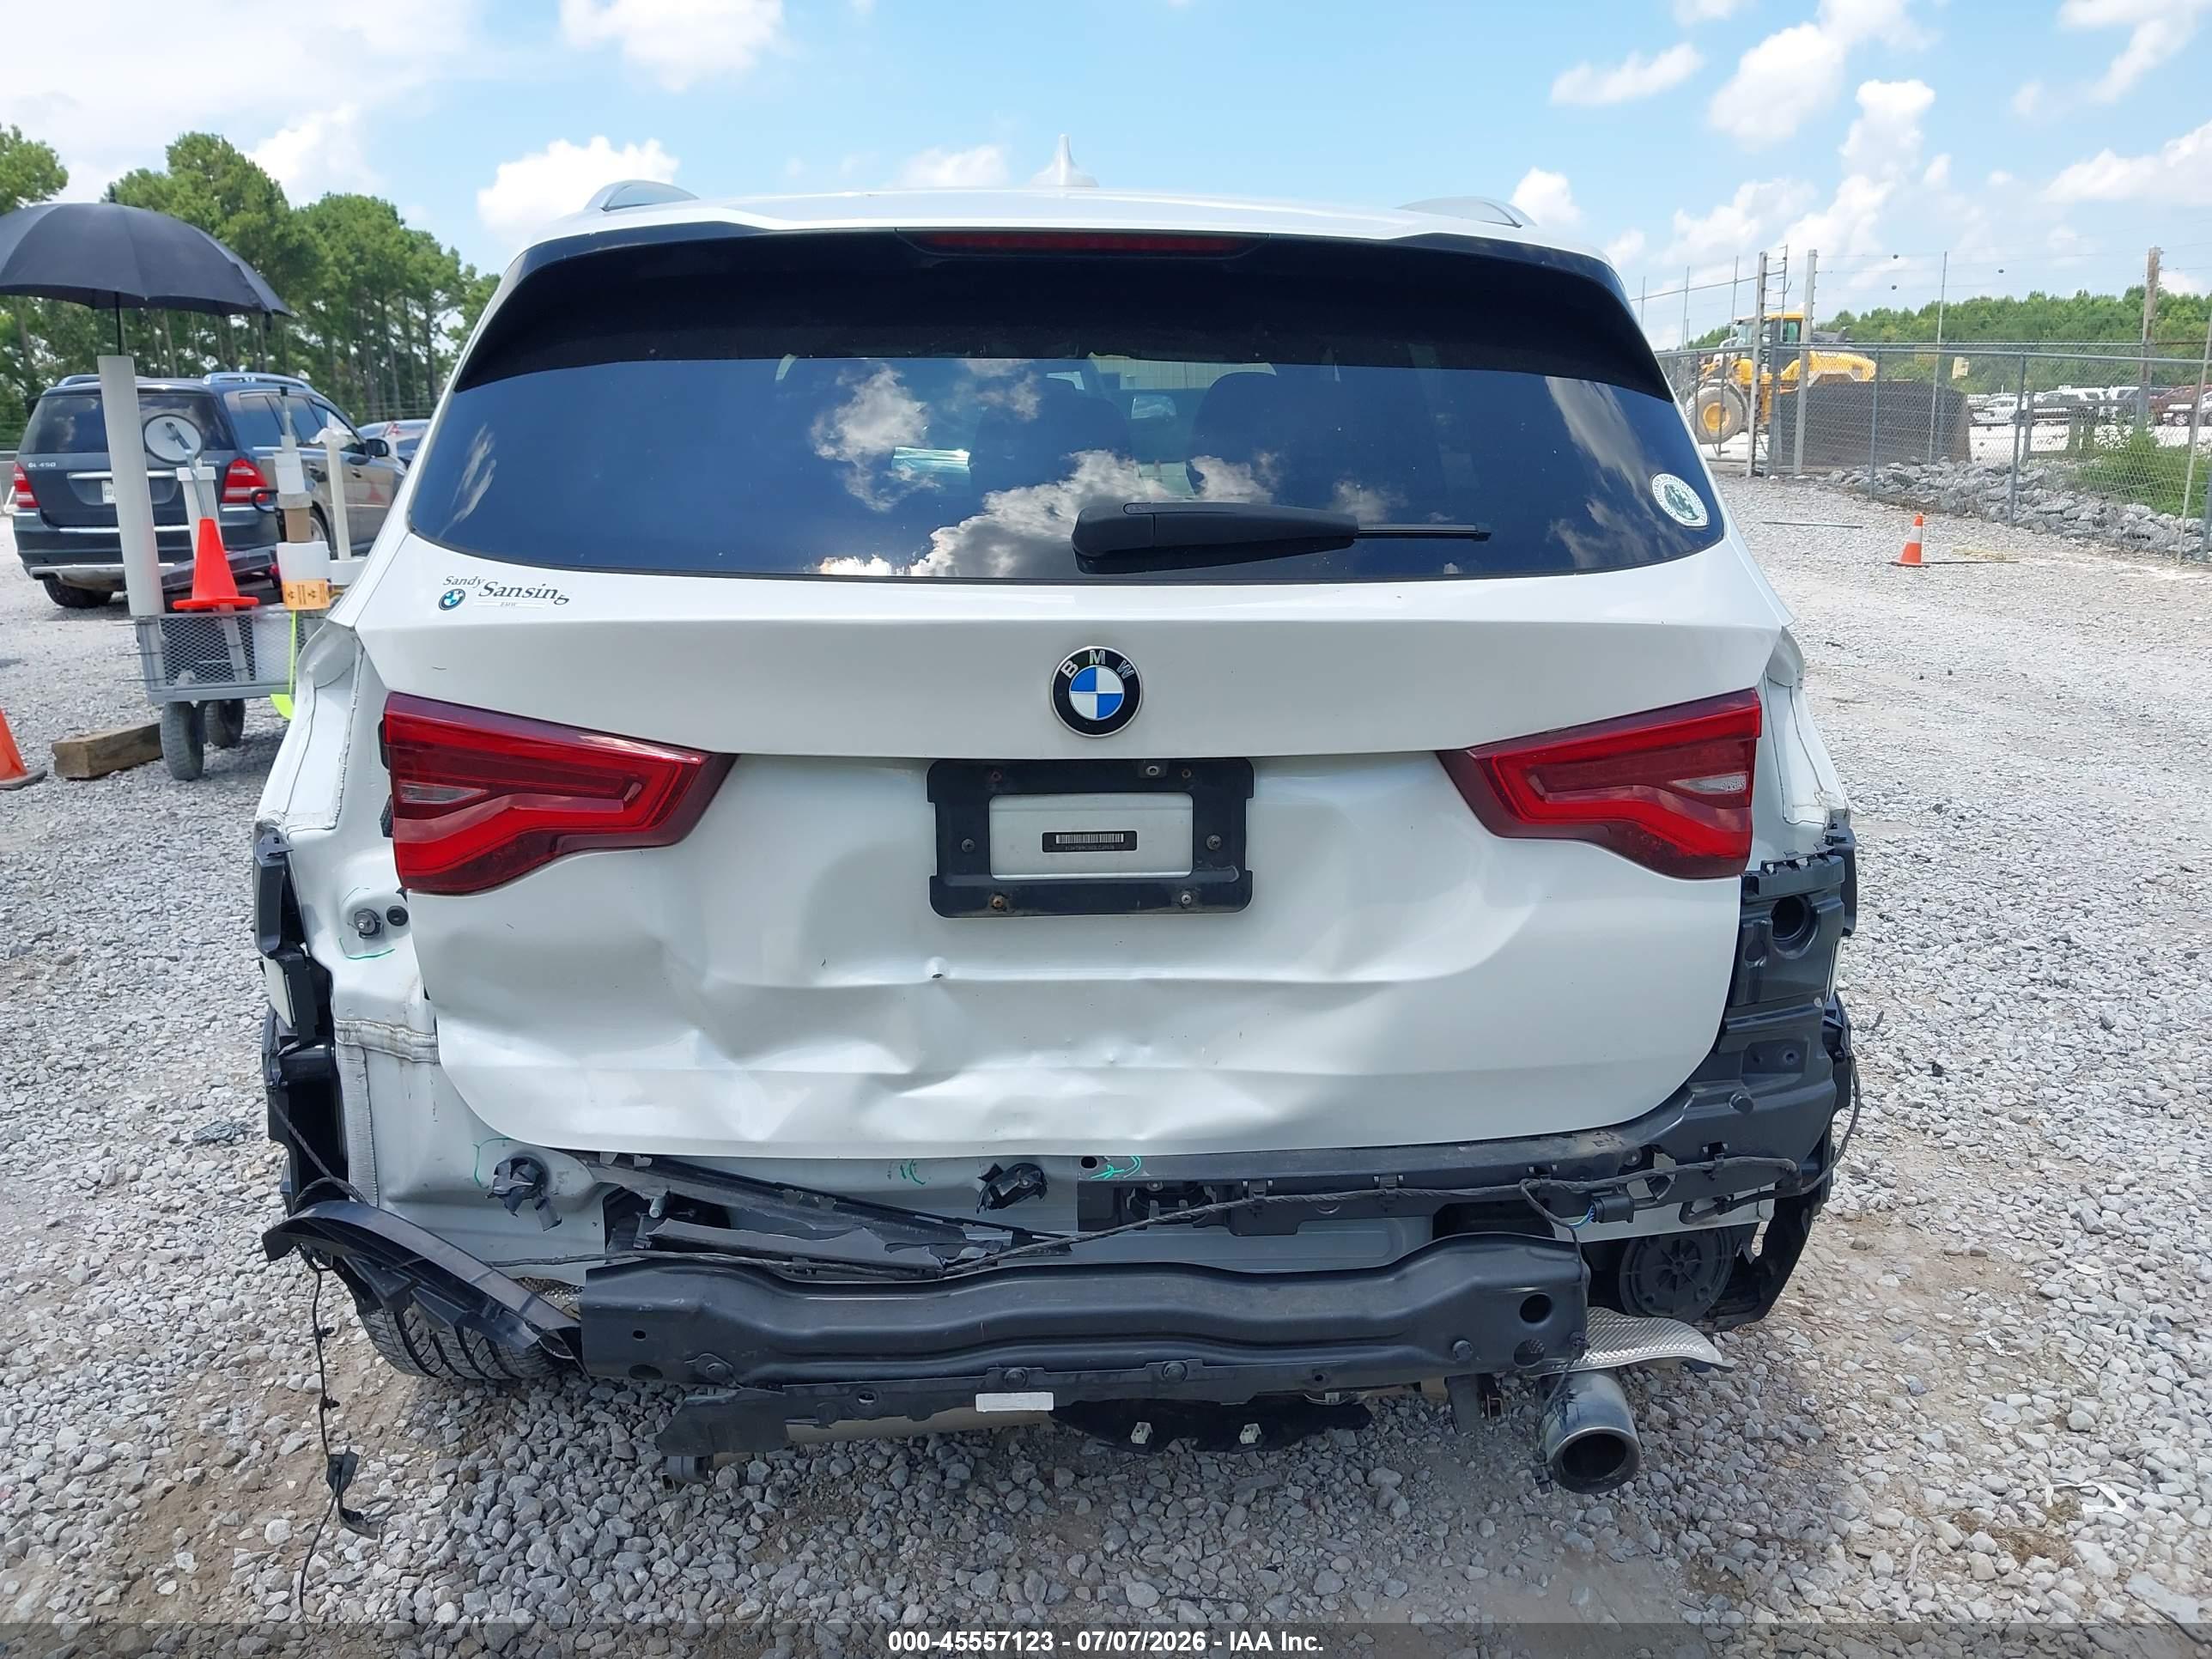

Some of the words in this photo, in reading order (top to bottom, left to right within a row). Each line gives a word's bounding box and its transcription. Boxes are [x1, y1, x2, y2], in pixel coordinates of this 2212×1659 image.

[443, 575, 485, 588] Sandy
[478, 580, 570, 605] Sansing
[1060, 649, 1134, 679] BMW
